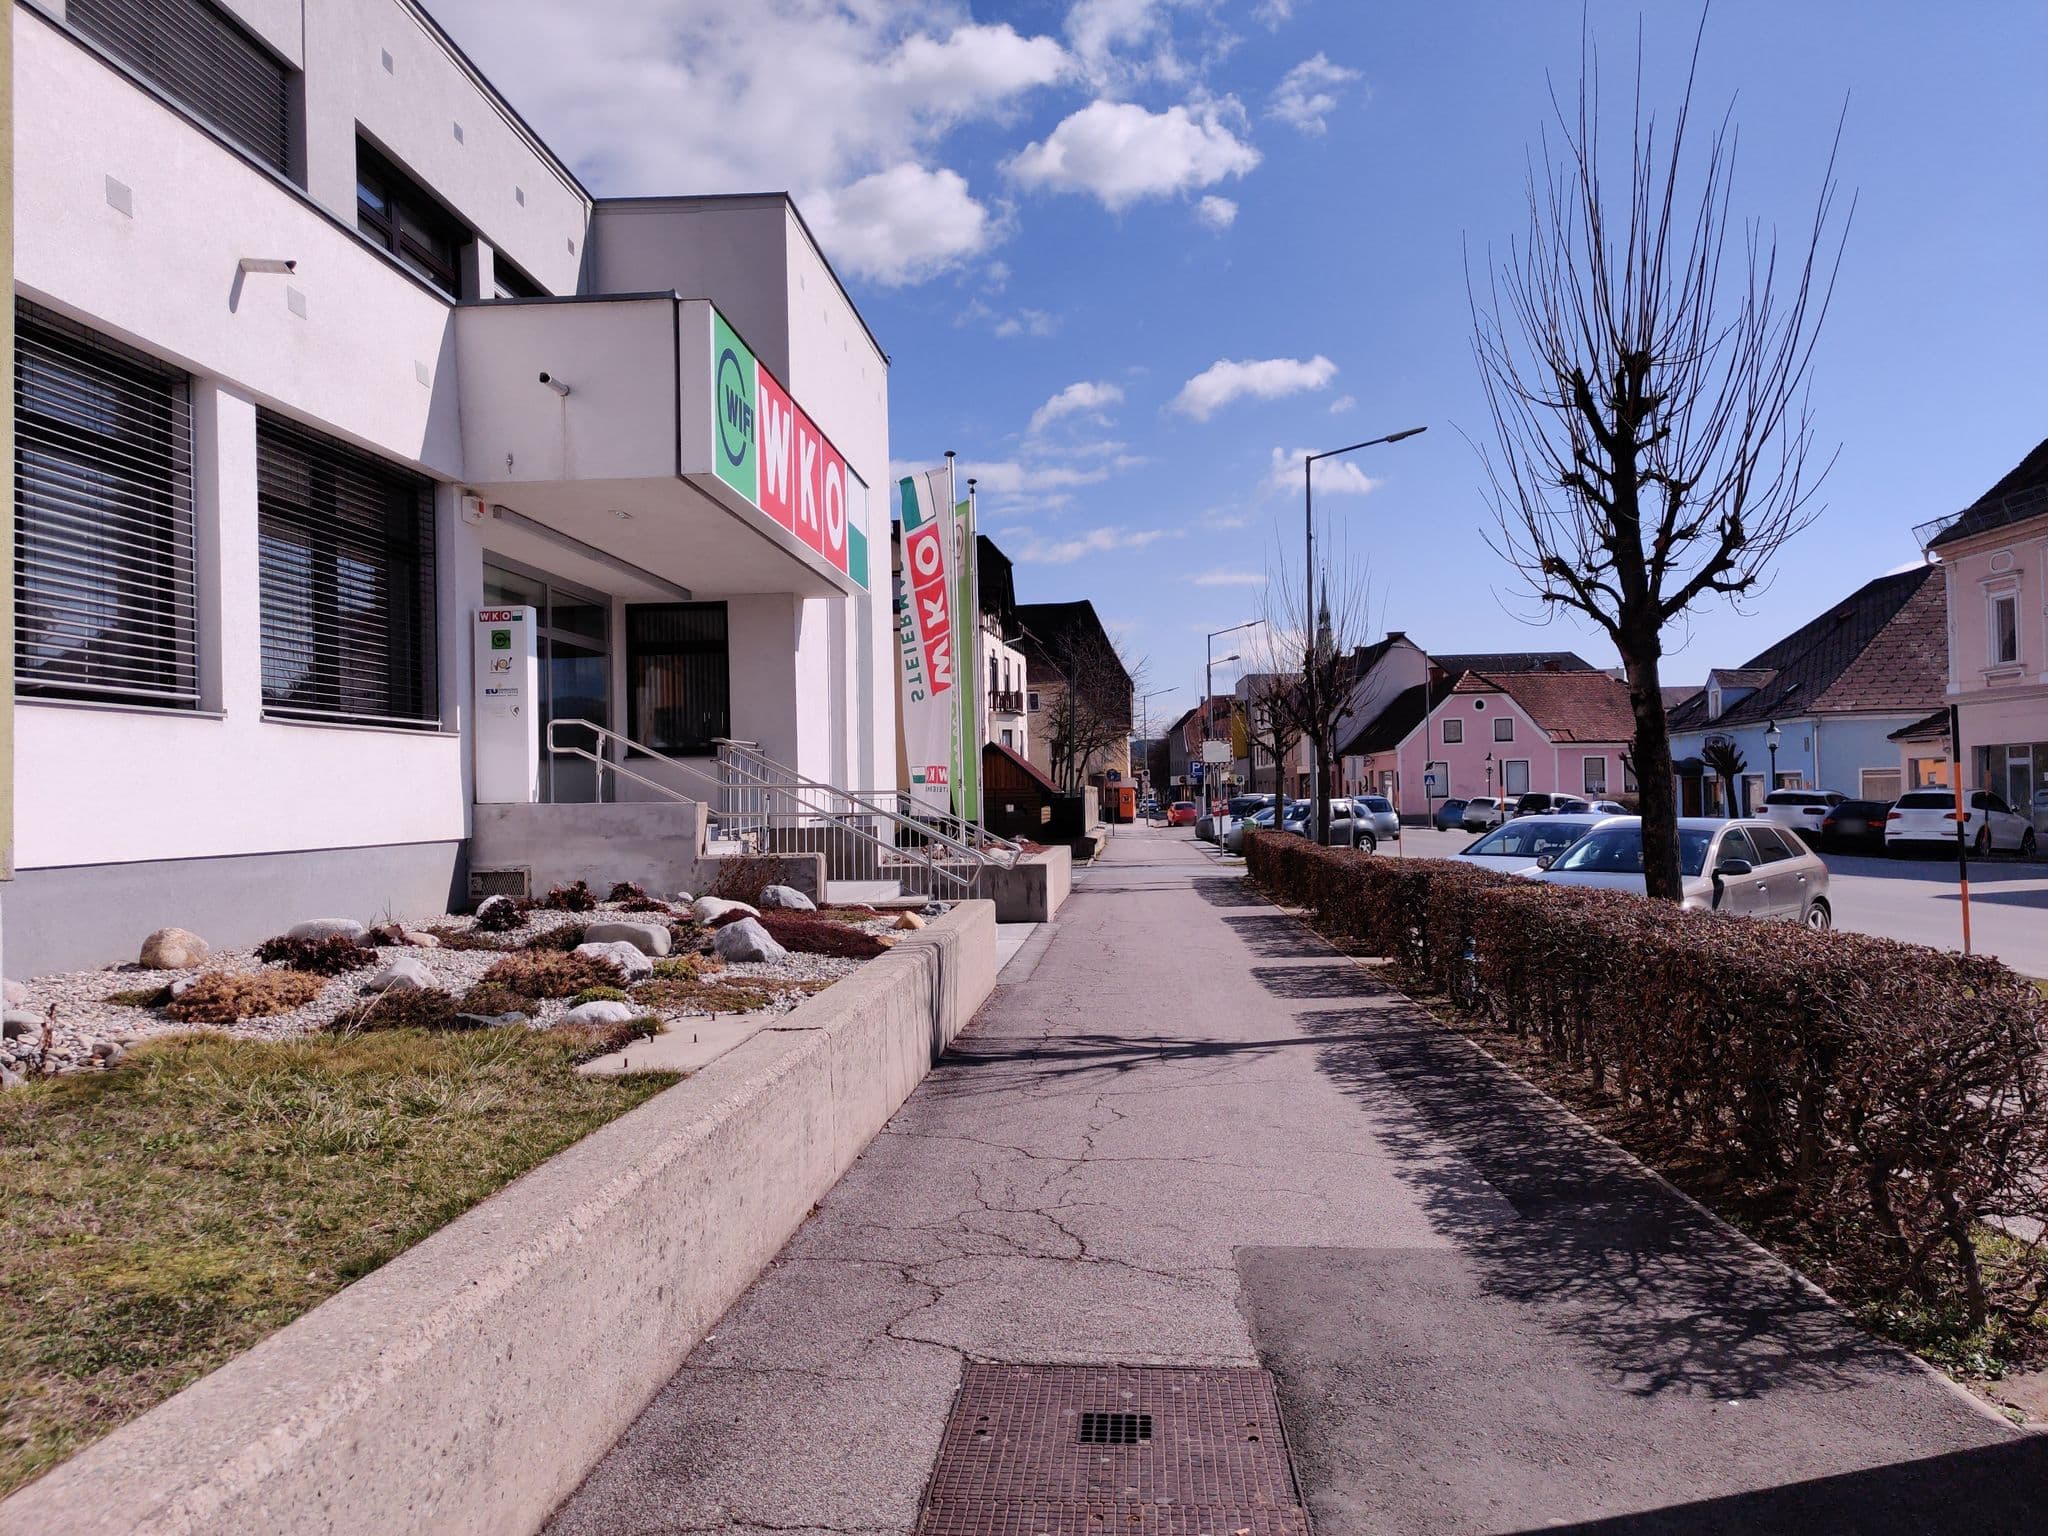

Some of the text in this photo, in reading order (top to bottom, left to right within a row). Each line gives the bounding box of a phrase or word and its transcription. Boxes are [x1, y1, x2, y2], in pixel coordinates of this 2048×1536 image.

[725, 383, 755, 445] WIFI
[760, 385, 844, 552] WKO
[480, 611, 510, 621] WKO
